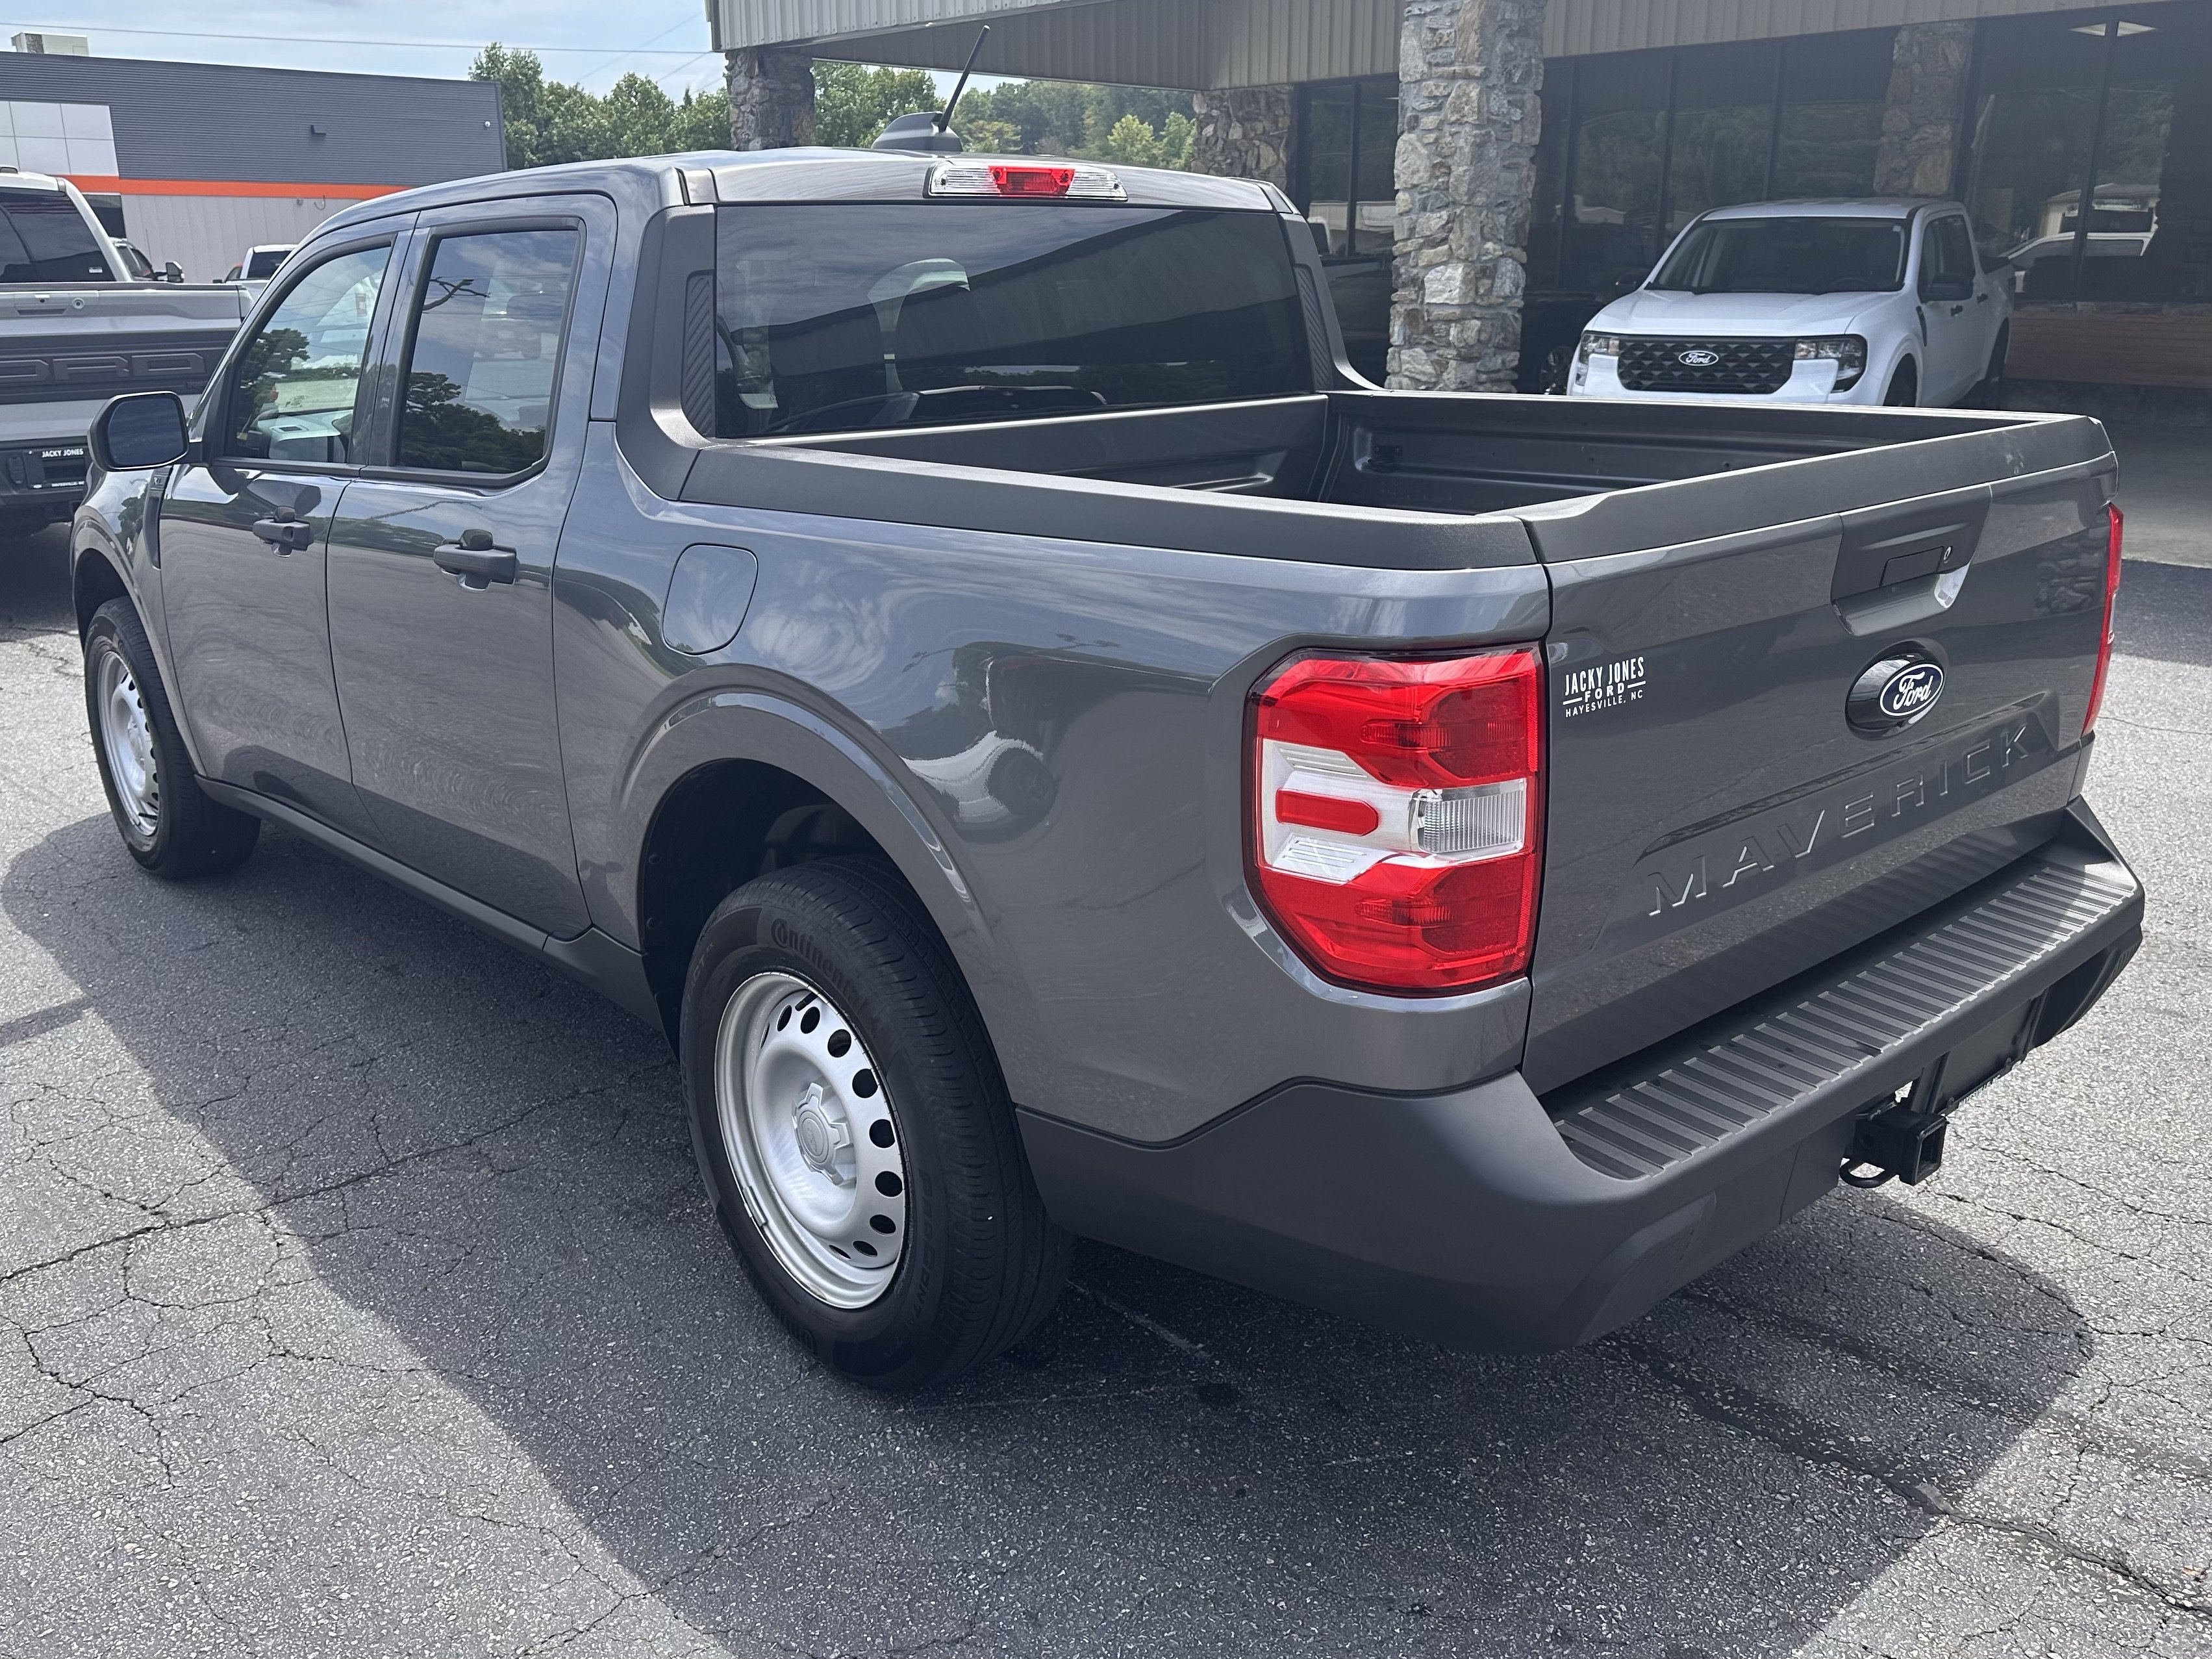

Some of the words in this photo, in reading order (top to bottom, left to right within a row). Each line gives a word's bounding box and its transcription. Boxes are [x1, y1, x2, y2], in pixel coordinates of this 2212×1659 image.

[42, 450, 62, 458] JACKY
[63, 448, 84, 457] JONES
[1565, 666, 1603, 696] JACKY
[1608, 656, 1644, 685] JONES
[1565, 694, 1626, 718] HAYESVILLE,
[1630, 689, 1643, 701] NC
[1585, 682, 1625, 703] FORD
[1648, 724, 2029, 917] MAVERICK
